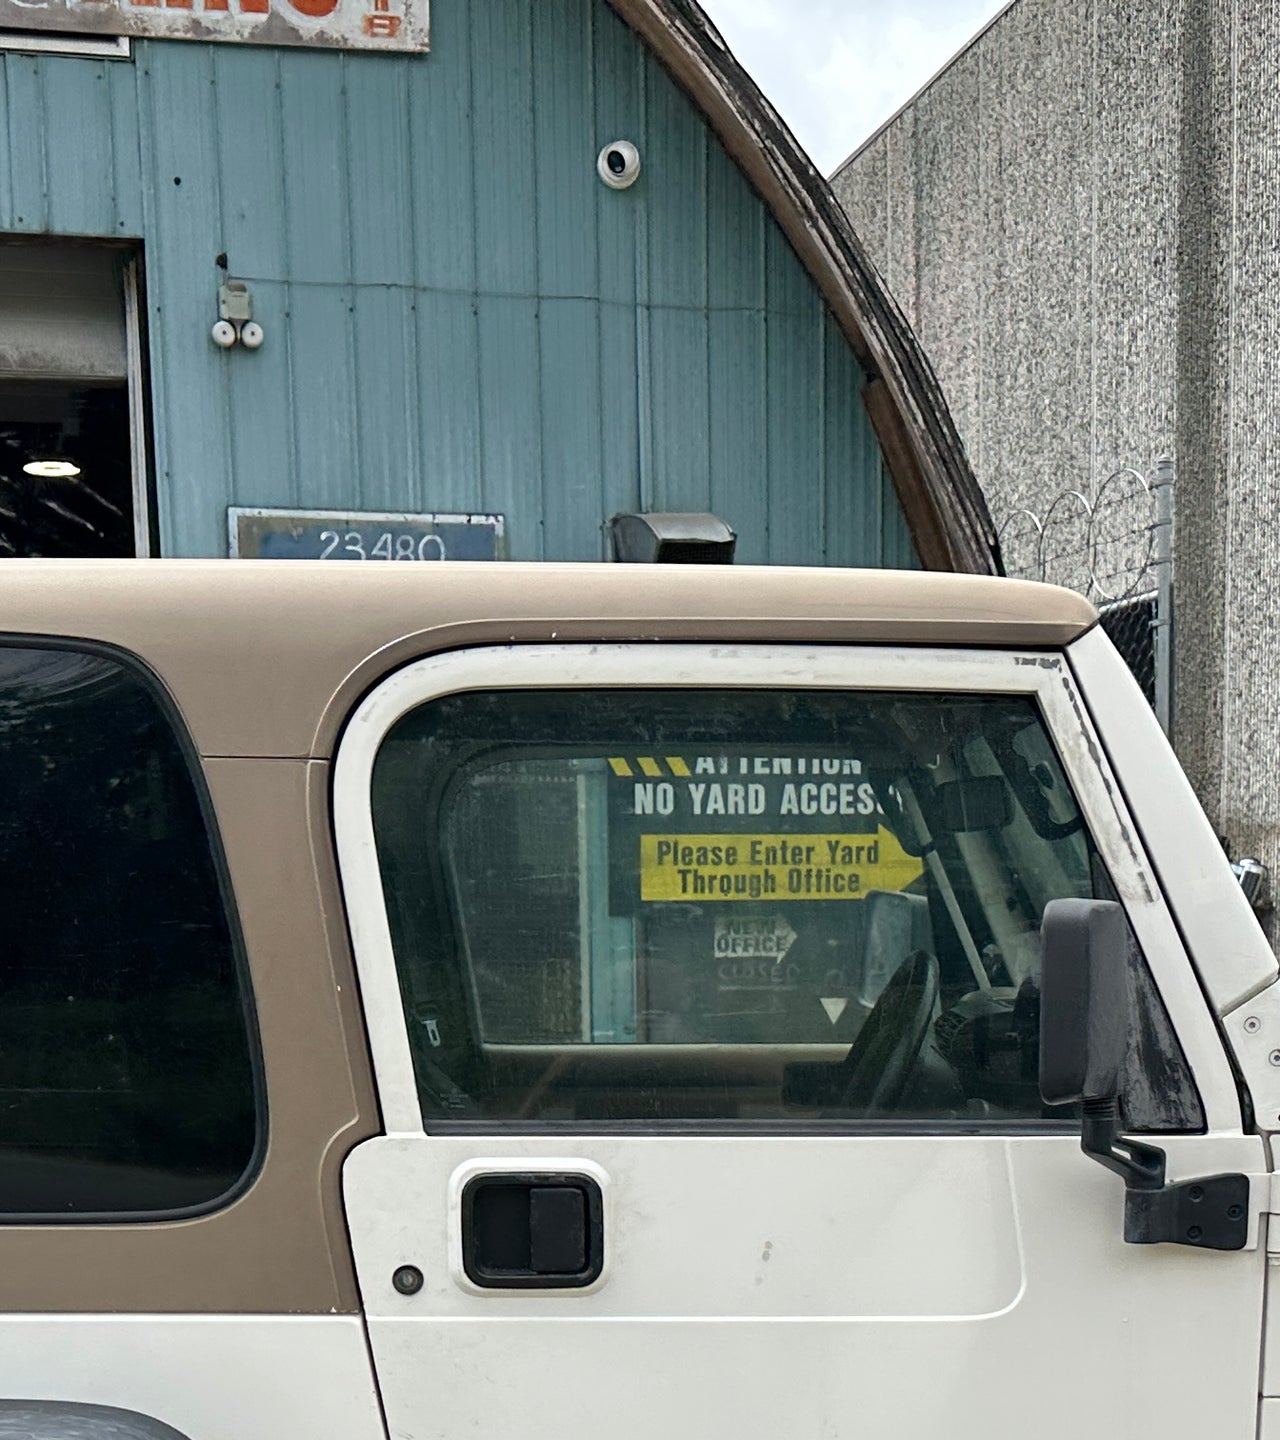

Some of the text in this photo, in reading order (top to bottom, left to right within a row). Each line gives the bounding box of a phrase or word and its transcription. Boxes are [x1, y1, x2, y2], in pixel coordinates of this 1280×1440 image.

[320, 530, 446, 560] 23480
[634, 782, 674, 815] NO
[688, 782, 766, 815] YARD
[657, 840, 879, 866] Please Enter Yard
[677, 869, 860, 897] Through Office
[727, 919, 776, 935] NEW
[717, 936, 787, 953] OFFICE
